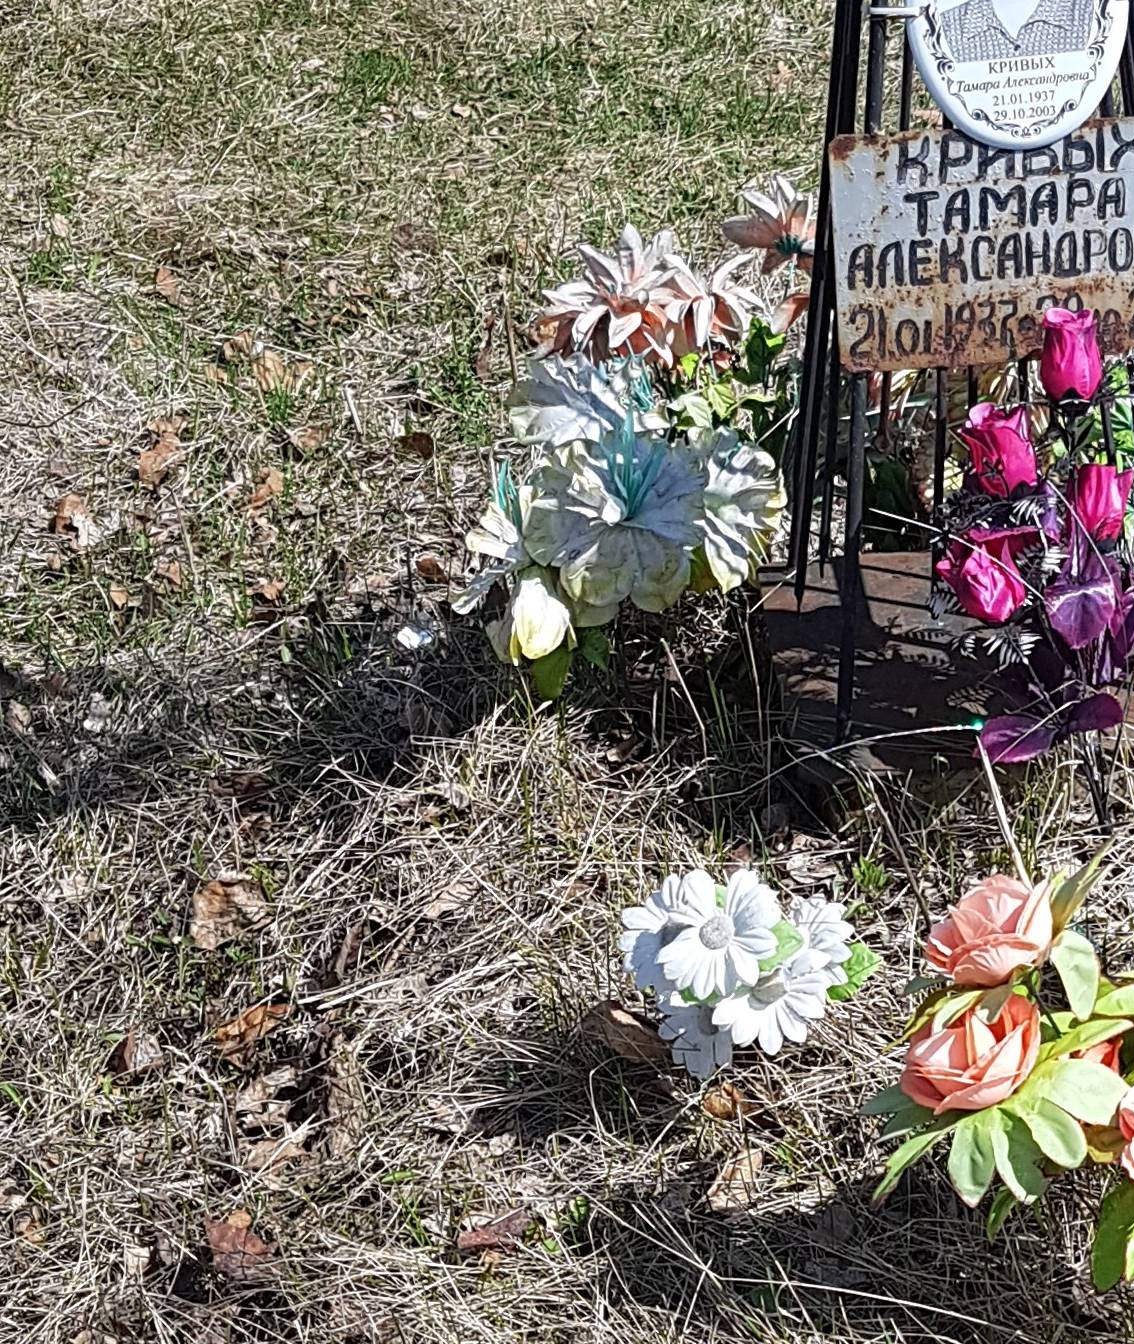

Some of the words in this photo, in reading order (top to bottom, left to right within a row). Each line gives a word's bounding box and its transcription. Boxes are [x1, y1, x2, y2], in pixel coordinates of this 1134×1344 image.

[988, 56, 1055, 74] КРИВЫХ
[957, 79, 1000, 93] Тамара
[1003, 71, 1090, 89] Александровна
[993, 90, 1055, 106] 21.01.1937
[994, 105, 1056, 121] 29.10.2003
[903, 177, 1126, 237] ТАМАРА
